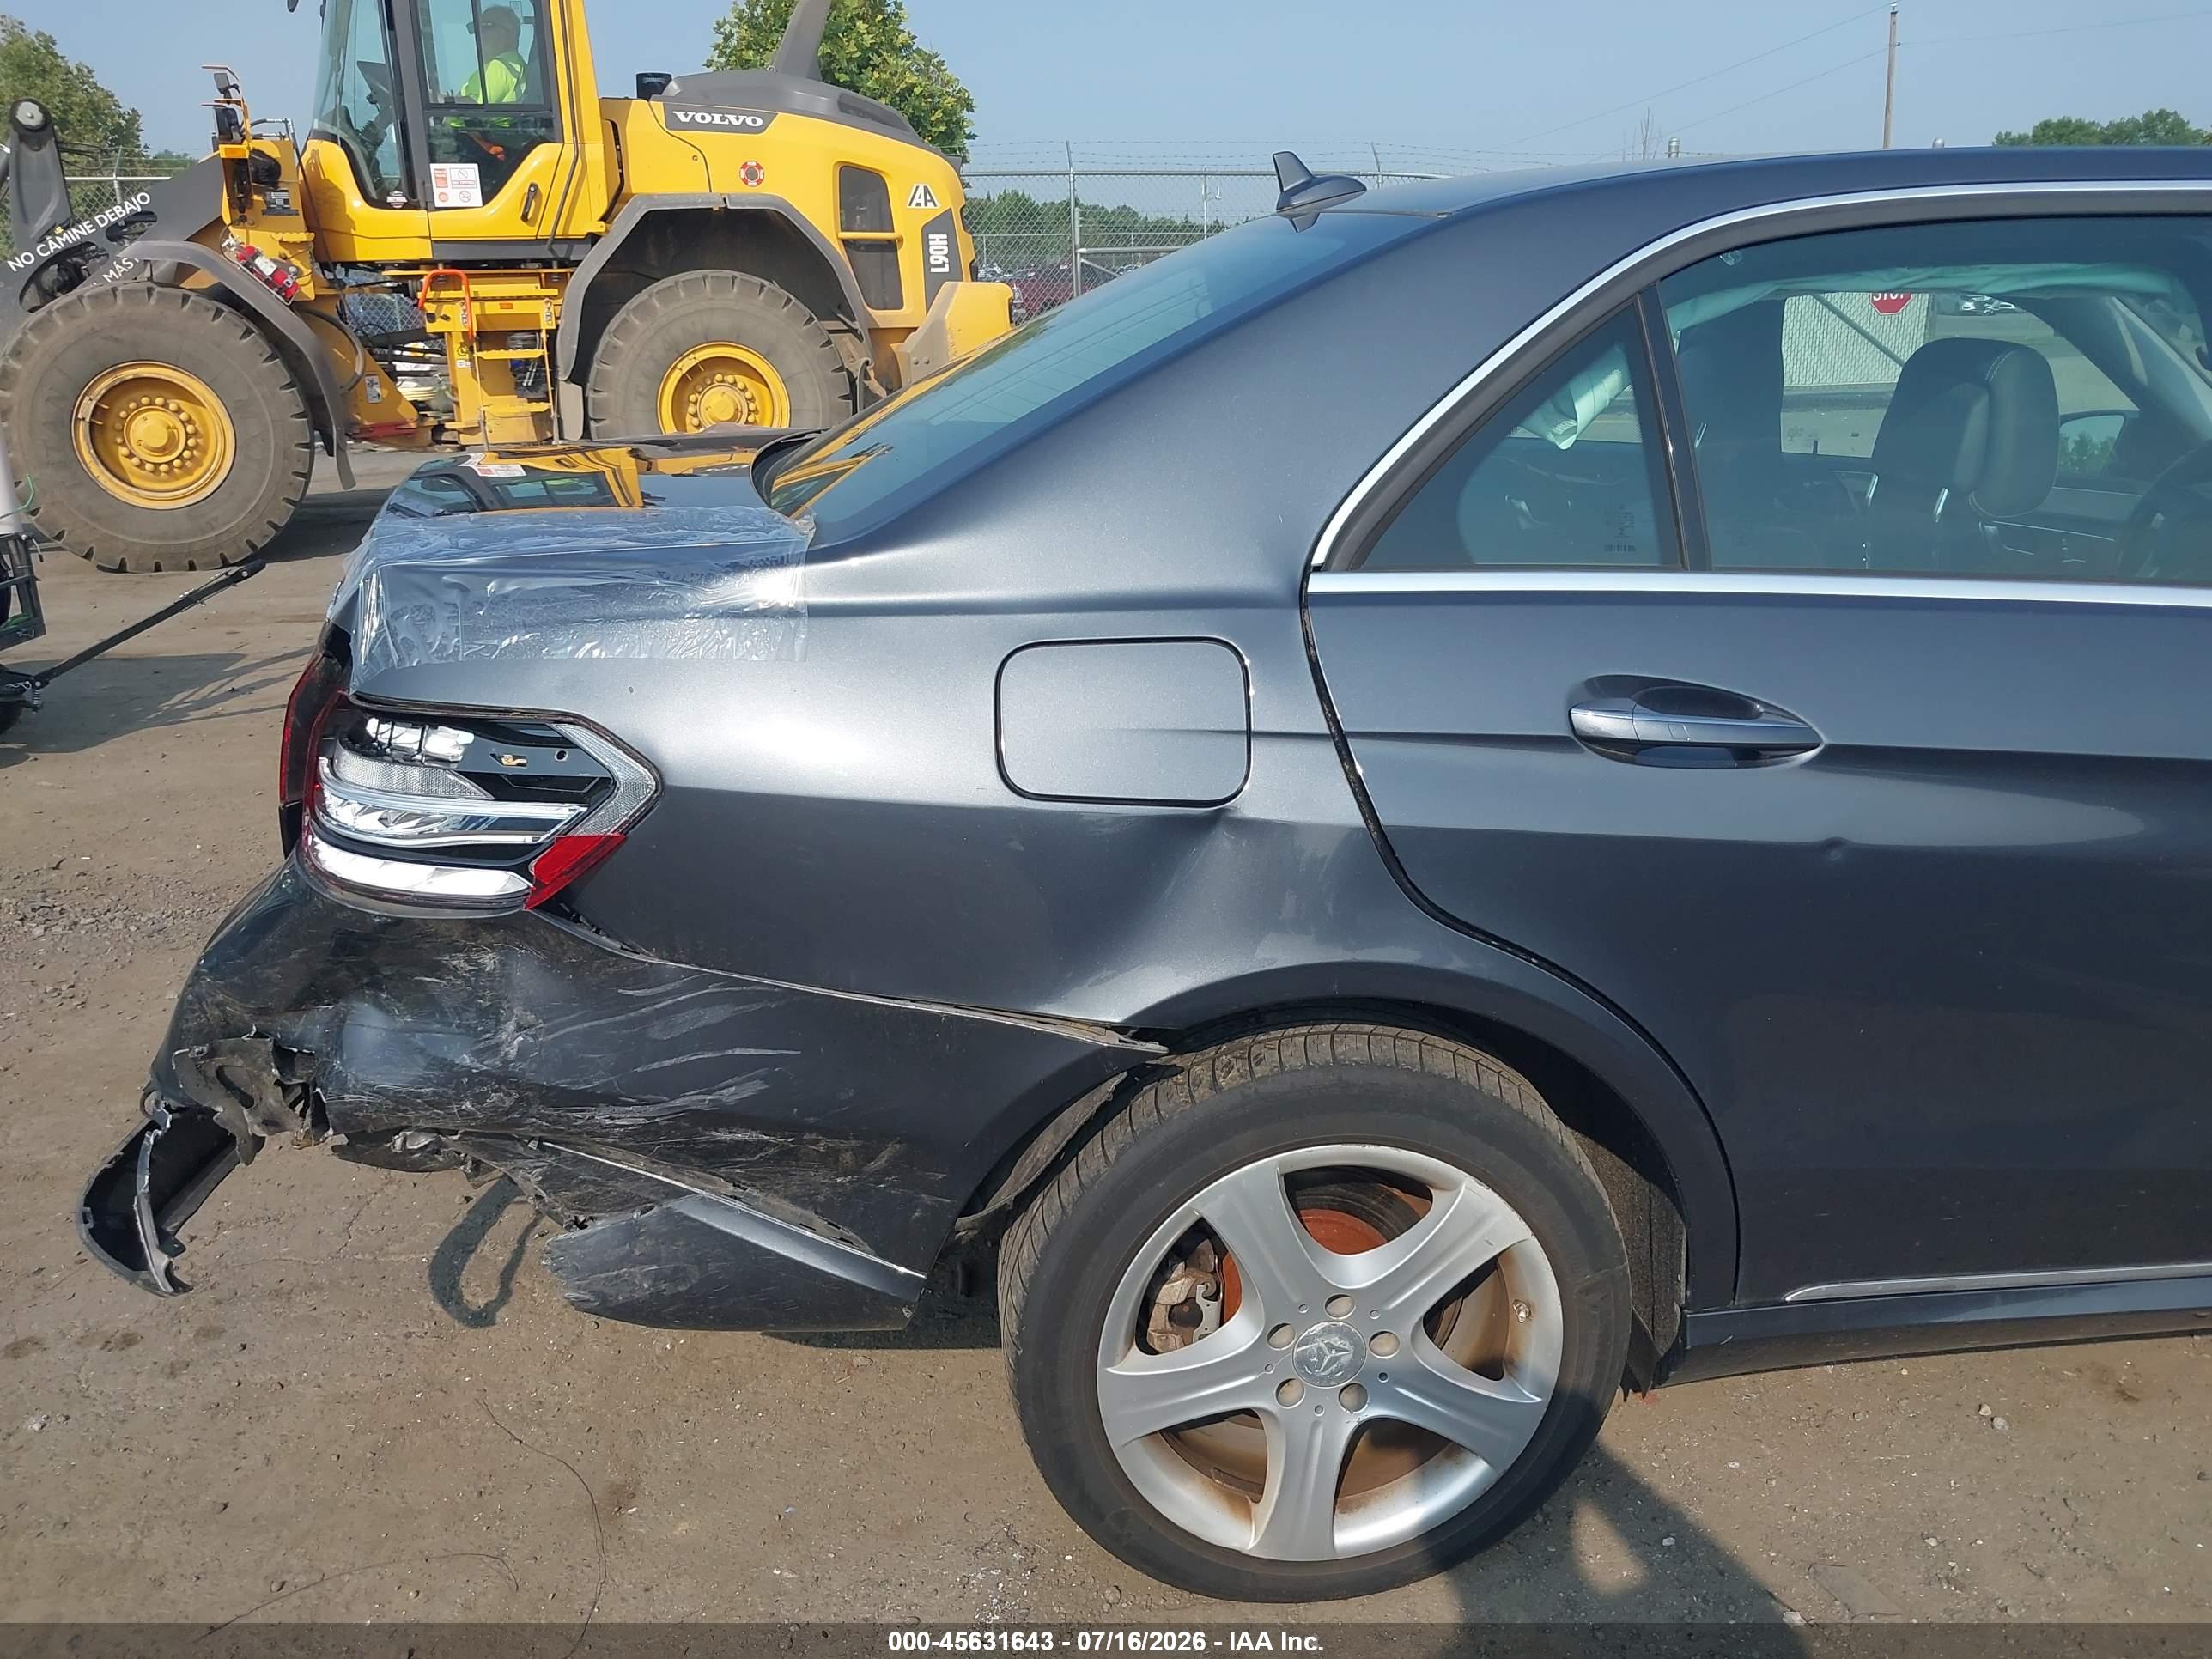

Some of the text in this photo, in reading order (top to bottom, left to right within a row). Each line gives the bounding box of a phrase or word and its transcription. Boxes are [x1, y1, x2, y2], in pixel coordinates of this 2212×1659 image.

[672, 111, 763, 127] VOLVO
[7, 252, 35, 272] NO
[94, 191, 150, 228] DEBAJO
[928, 234, 950, 273] L90H
[103, 258, 140, 283] MÁS
